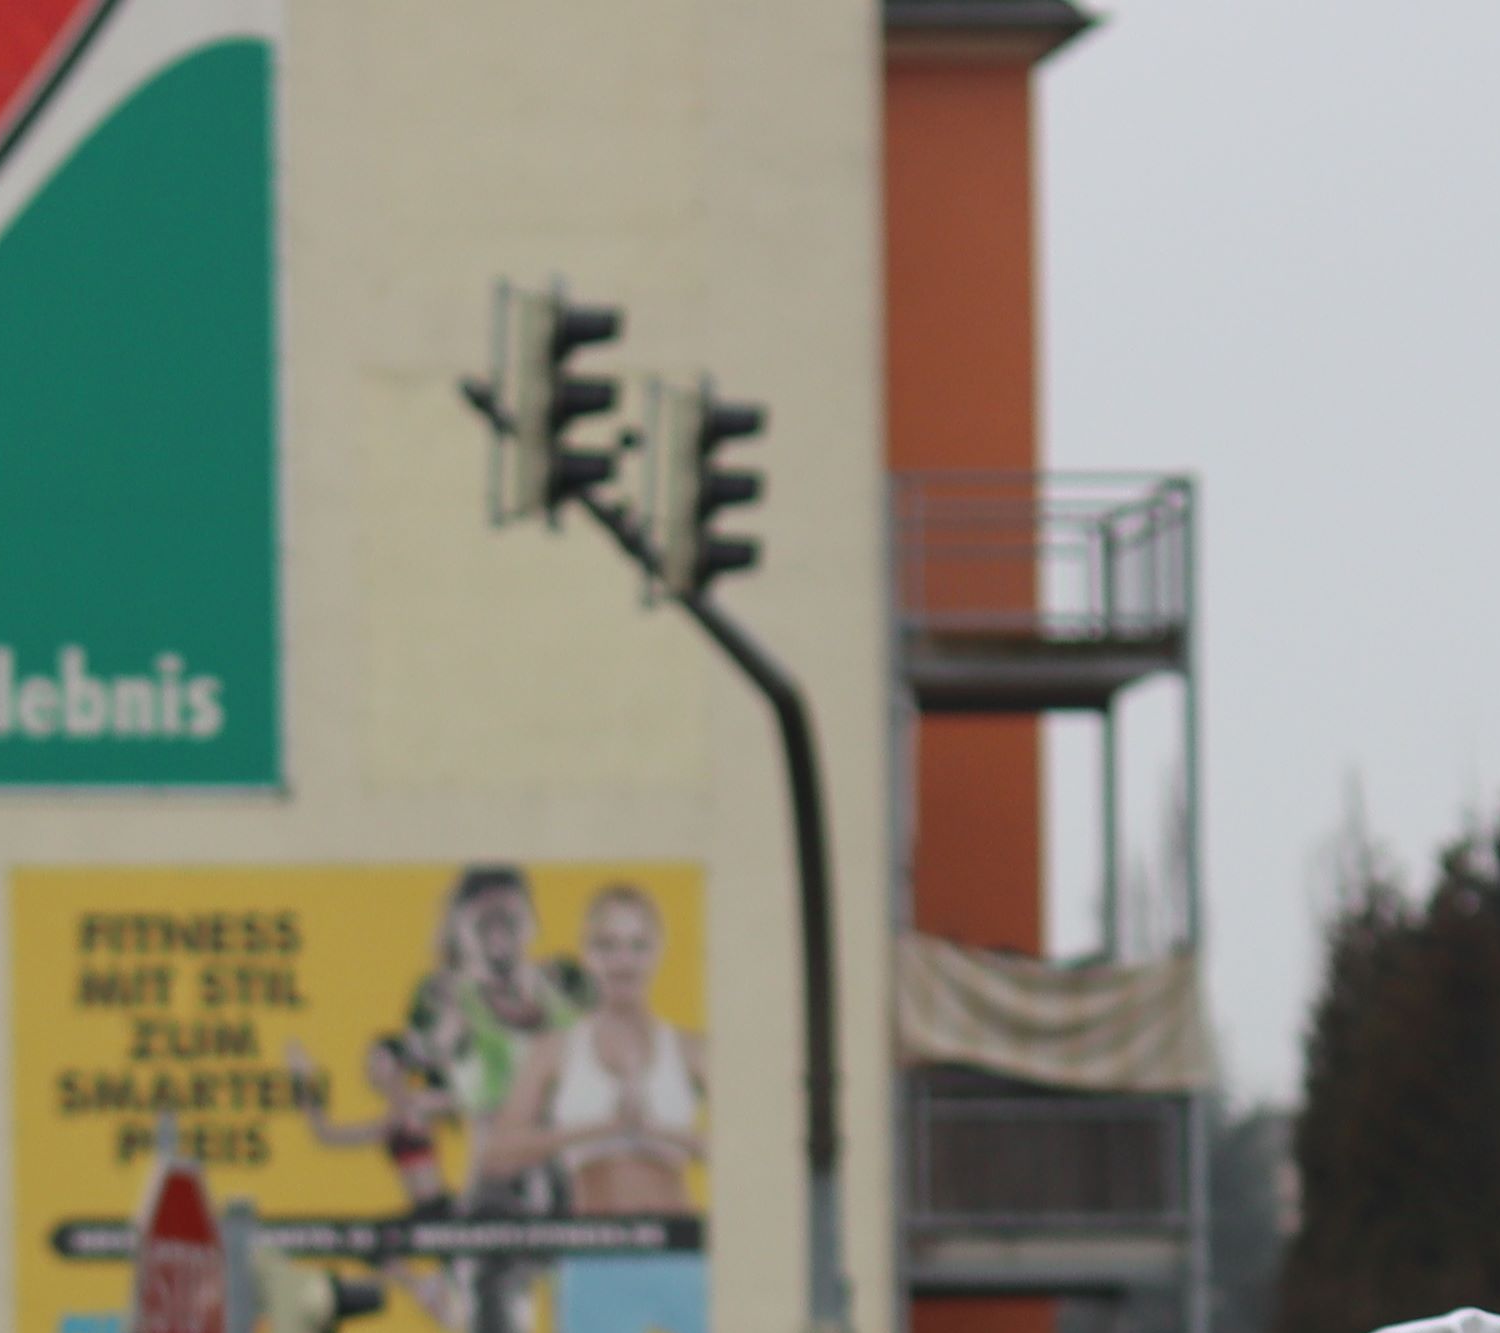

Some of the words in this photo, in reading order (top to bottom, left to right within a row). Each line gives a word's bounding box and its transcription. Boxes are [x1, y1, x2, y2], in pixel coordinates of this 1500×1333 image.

[79, 912, 302, 954] FITNESS
[78, 967, 171, 1006] MIT
[201, 967, 304, 1006] STIL
[131, 1021, 258, 1060] ZUM
[59, 1070, 331, 1113] SMARTEN
